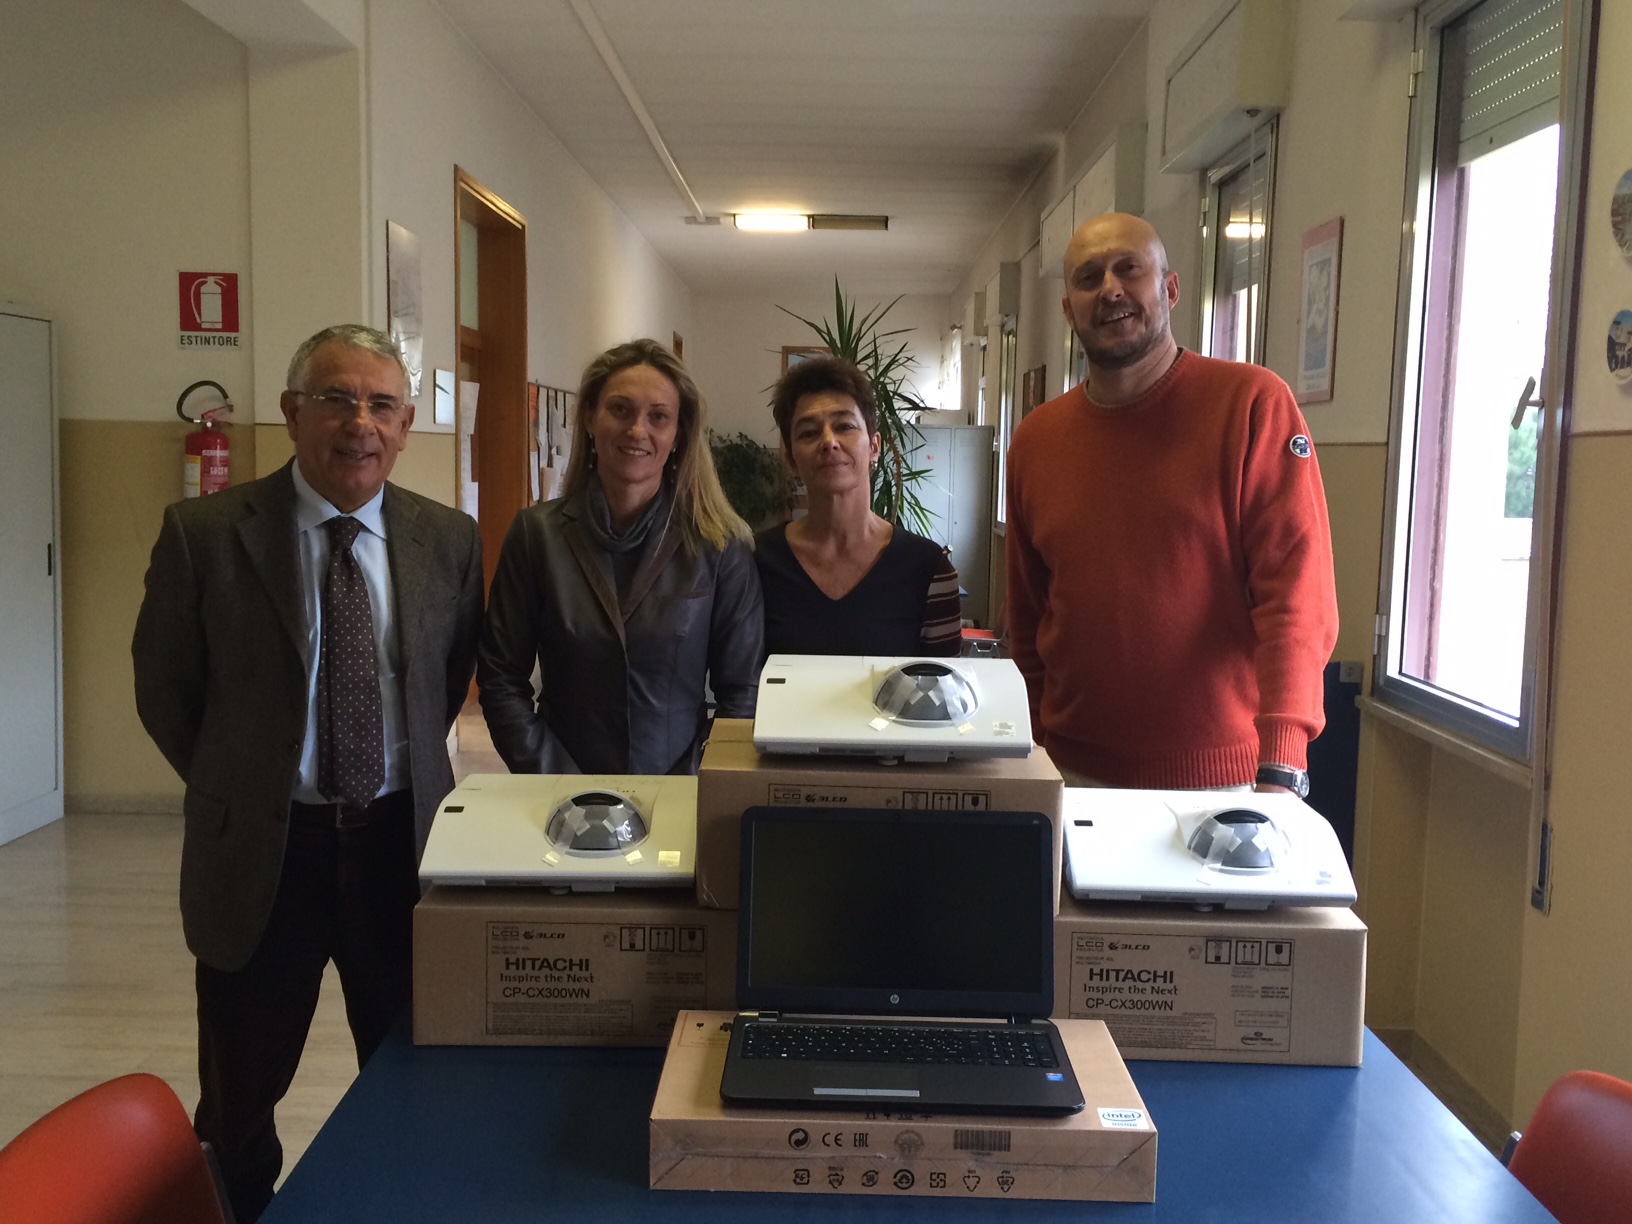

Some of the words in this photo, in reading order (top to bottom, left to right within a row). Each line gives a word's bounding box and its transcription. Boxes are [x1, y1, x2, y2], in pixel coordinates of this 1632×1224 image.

[180, 334, 239, 346] ESTINTORE
[773, 792, 801, 800] LCD
[1076, 940, 1105, 948] LCD
[504, 957, 590, 972] HITACHI
[499, 972, 541, 984] Inspire
[544, 973, 564, 983] the
[566, 973, 595, 984] Next
[1088, 967, 1174, 984] HITACHI
[502, 986, 590, 999] CP-CX300WN
[1083, 983, 1125, 995] Inspire
[1127, 984, 1148, 995] the
[1150, 985, 1179, 996] Next
[1085, 997, 1174, 1012] CP-CX300WN
[1106, 1111, 1136, 1119] intel
